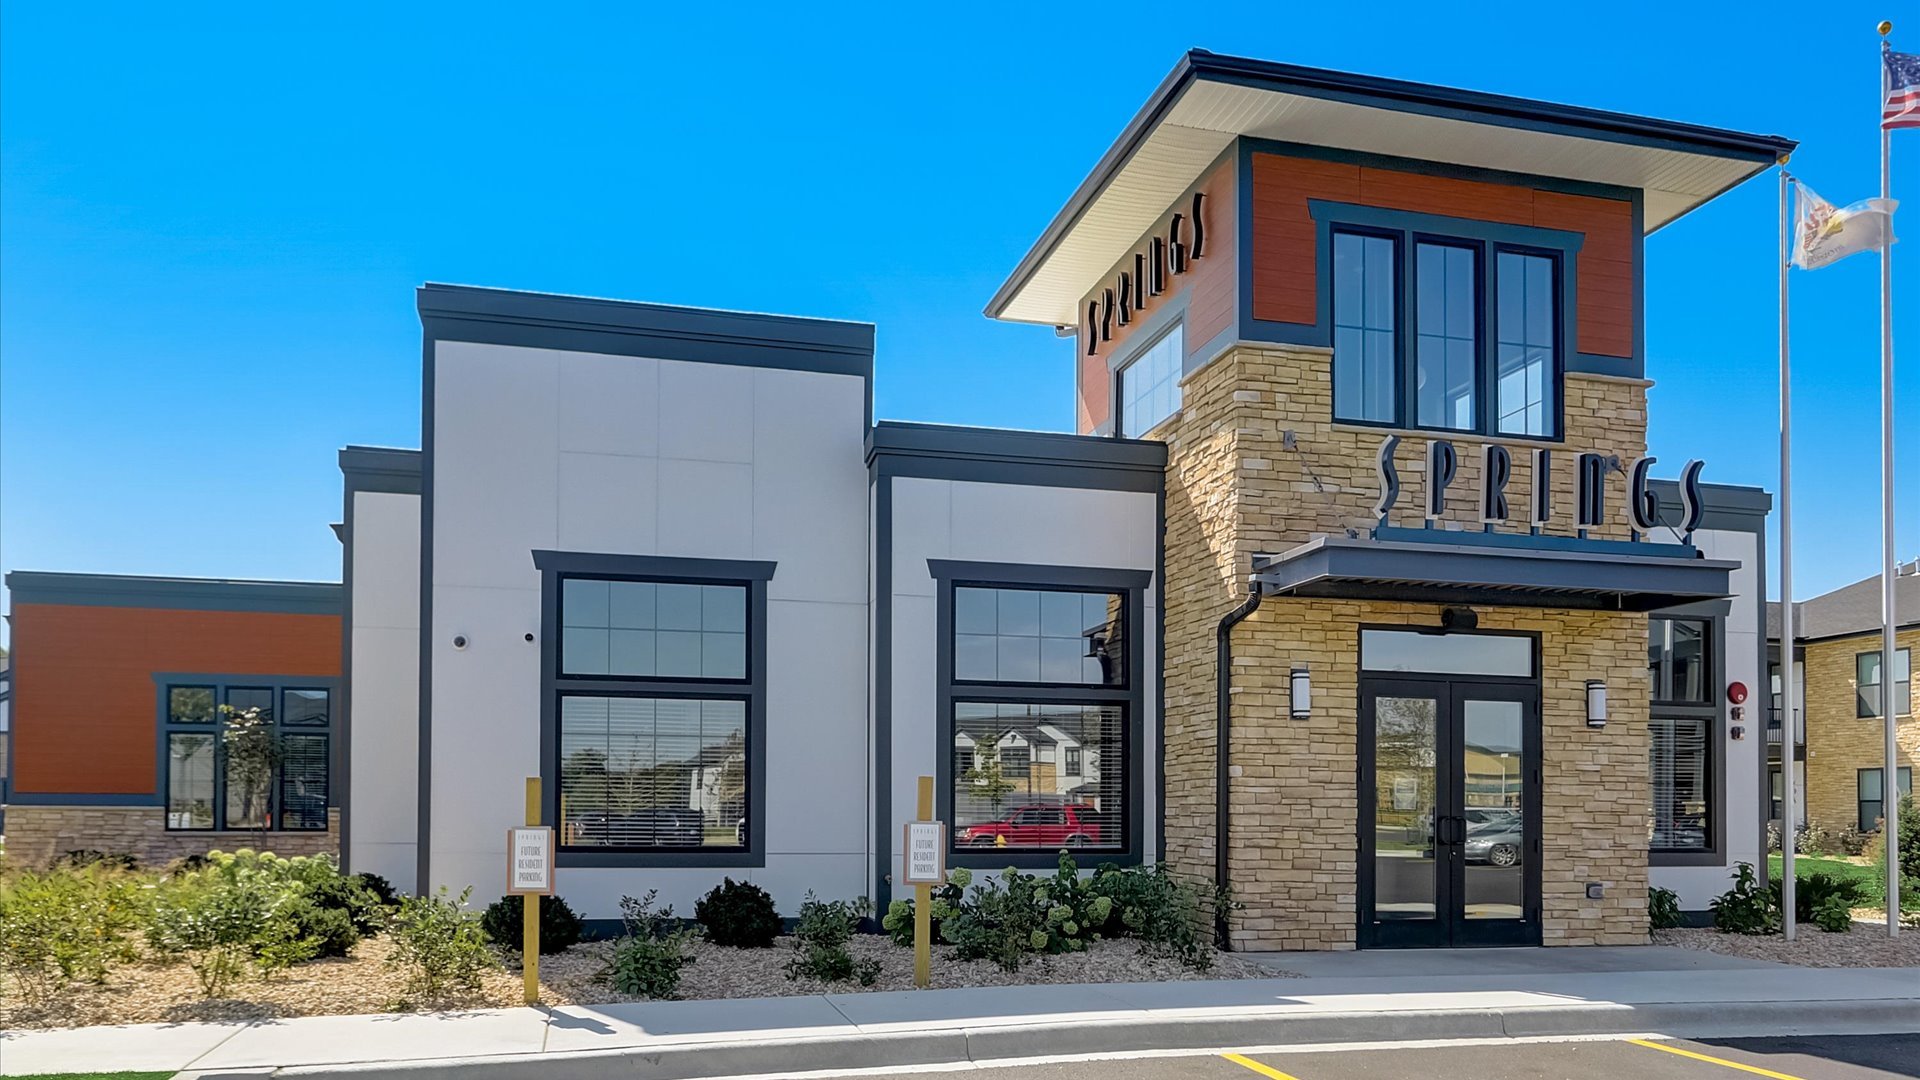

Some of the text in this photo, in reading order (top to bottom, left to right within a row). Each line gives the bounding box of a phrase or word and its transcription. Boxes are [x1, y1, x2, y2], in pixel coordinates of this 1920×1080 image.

[1087, 192, 1206, 356] SPRINGS
[1373, 434, 1705, 538] SPRINGS
[915, 839, 934, 849] FUTURE
[520, 845, 542, 856] FUTURE
[913, 851, 935, 861] RESIDENT
[518, 858, 543, 869] RESIDENT
[914, 863, 935, 873] PARKING
[518, 872, 542, 882] PARKING
